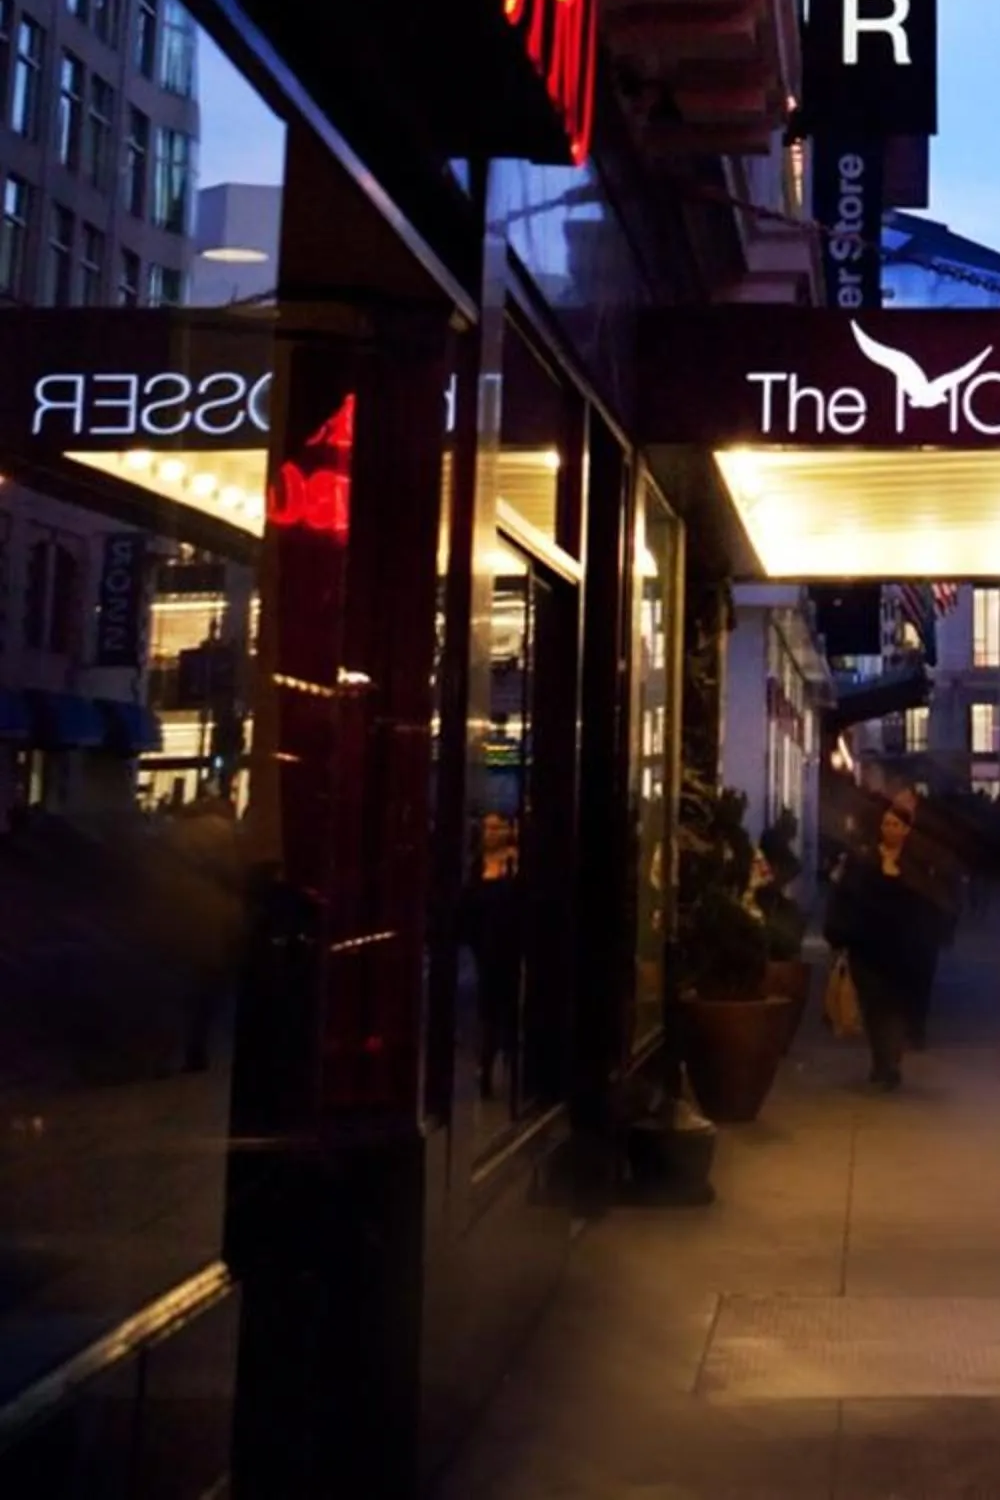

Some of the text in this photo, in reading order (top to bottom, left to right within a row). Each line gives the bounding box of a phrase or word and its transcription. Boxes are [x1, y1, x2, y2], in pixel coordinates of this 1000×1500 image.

[828, 151, 865, 309] er Store
[746, 372, 868, 435] The
